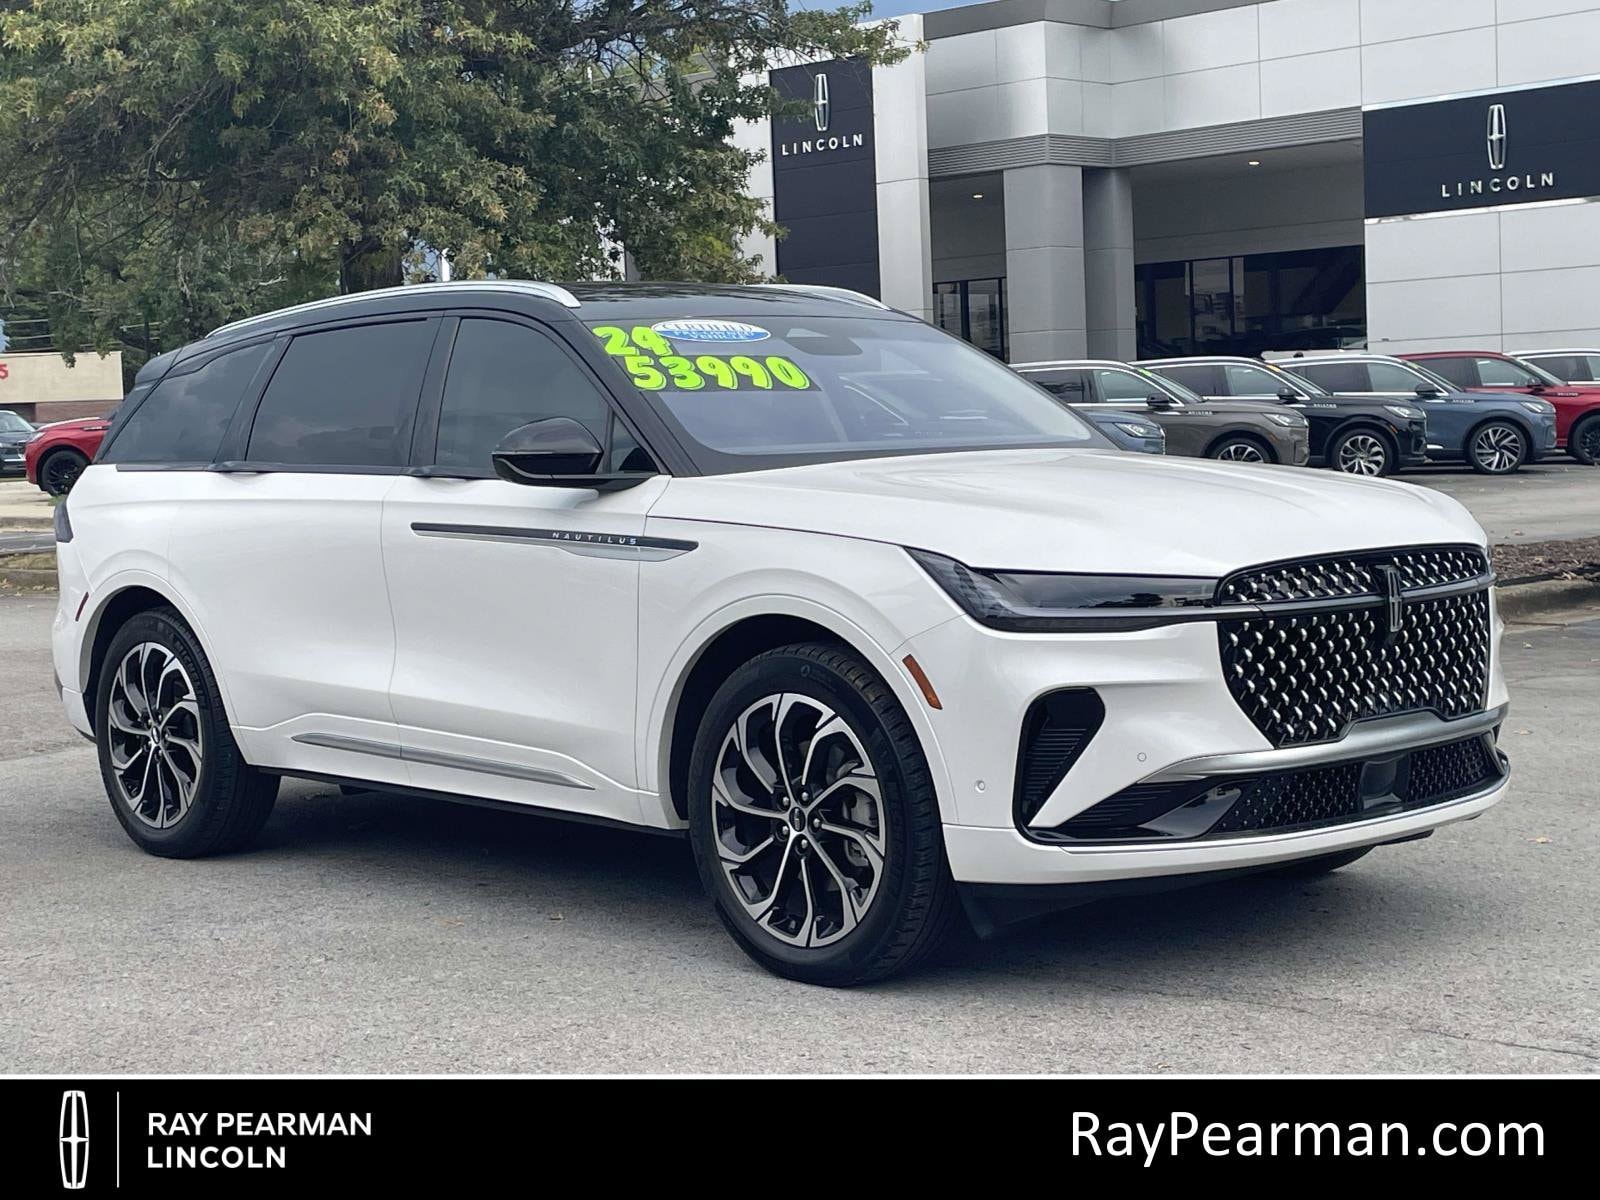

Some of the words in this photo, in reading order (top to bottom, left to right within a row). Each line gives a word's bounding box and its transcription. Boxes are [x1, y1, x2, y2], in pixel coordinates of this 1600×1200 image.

[782, 134, 862, 156] LINCOLN
[1441, 172, 1554, 198] LINCOLN
[592, 326, 674, 356] 24
[624, 356, 810, 390] 53990
[552, 532, 637, 545] NAUTILUS
